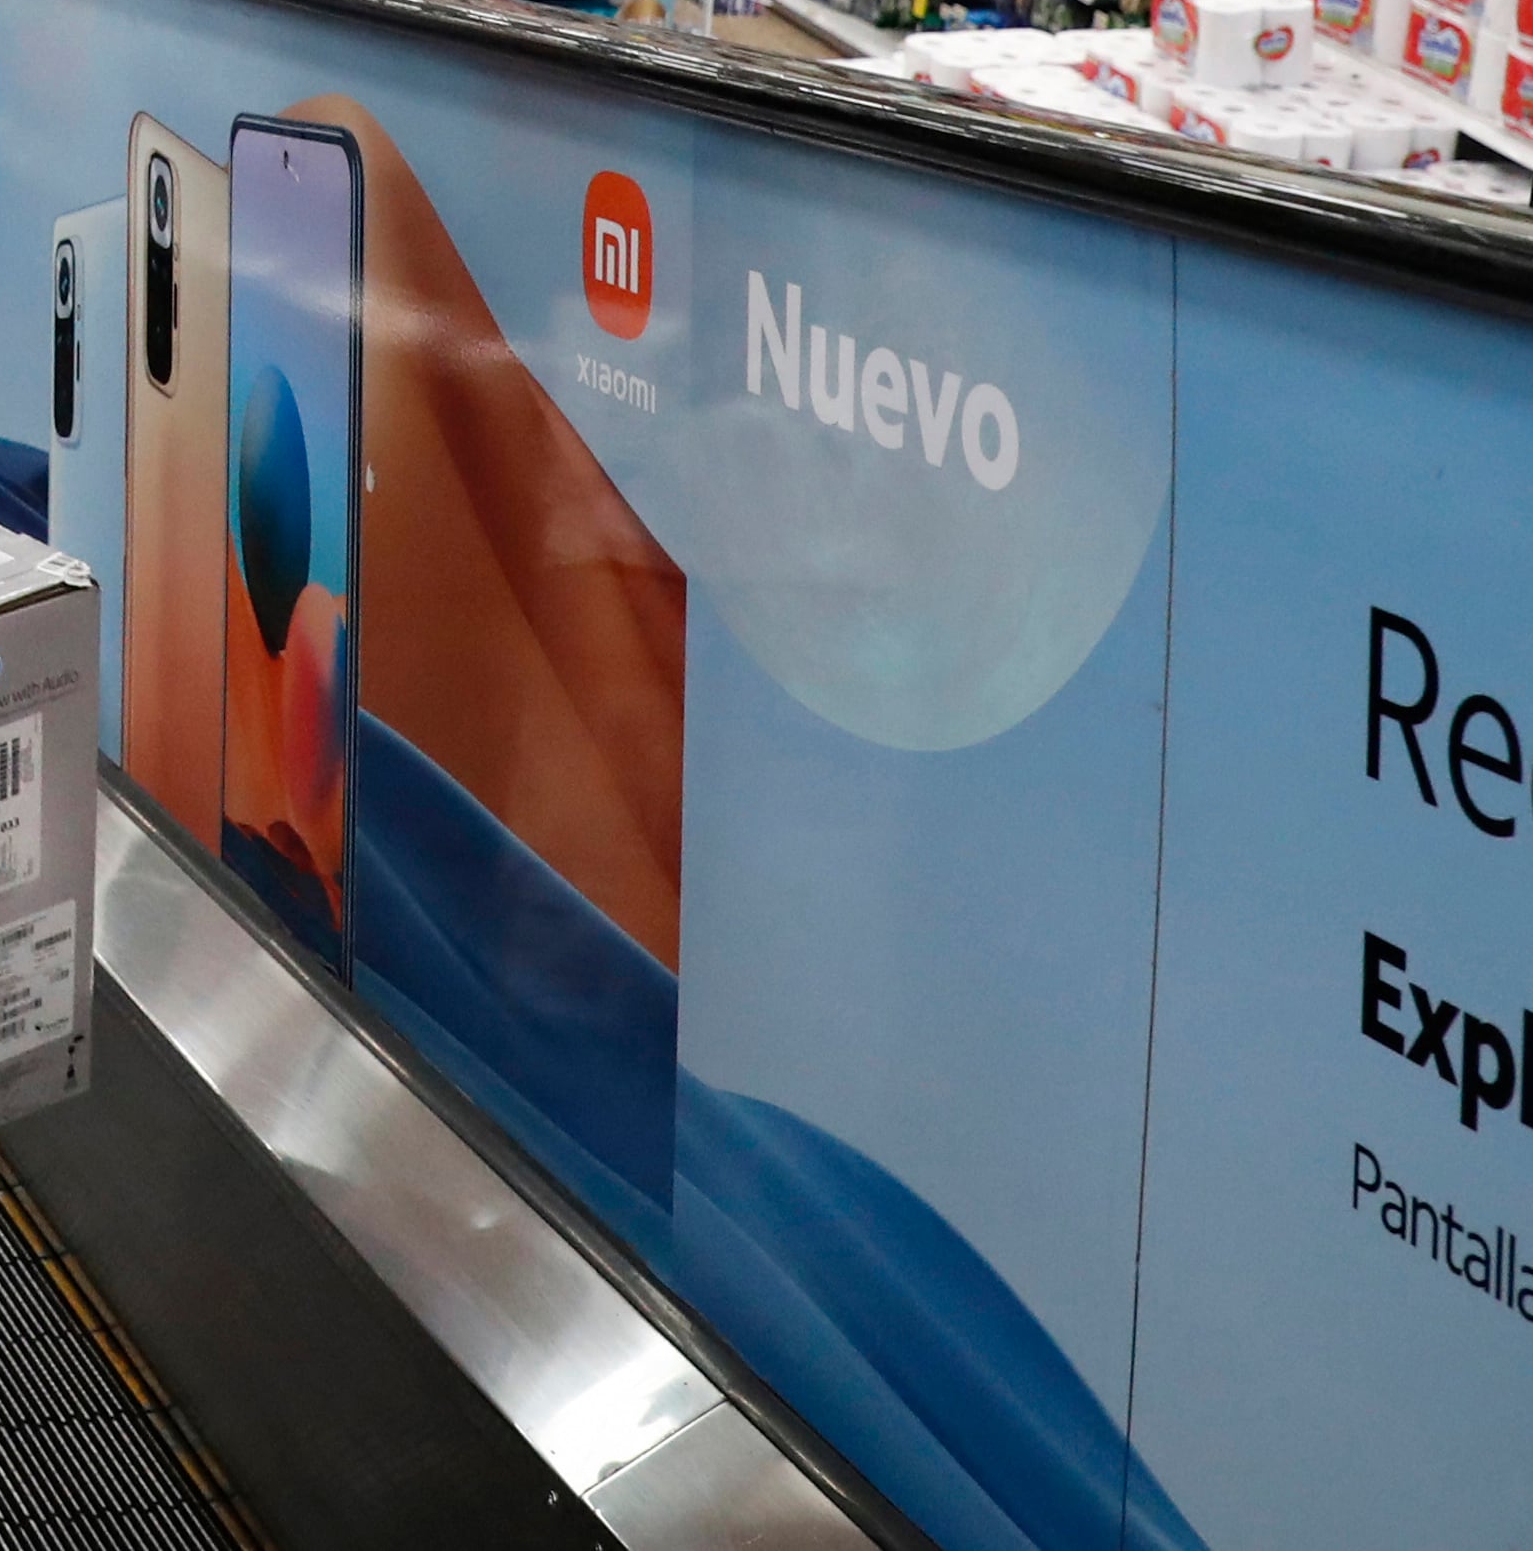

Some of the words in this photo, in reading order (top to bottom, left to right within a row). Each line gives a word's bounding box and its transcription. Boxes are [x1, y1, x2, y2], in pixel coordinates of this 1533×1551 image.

[575, 351, 658, 416] xiaomi
[744, 269, 1021, 492] Nuevo
[12, 682, 42, 703] with
[42, 670, 80, 692] Audio
[1364, 605, 1533, 840] Re
